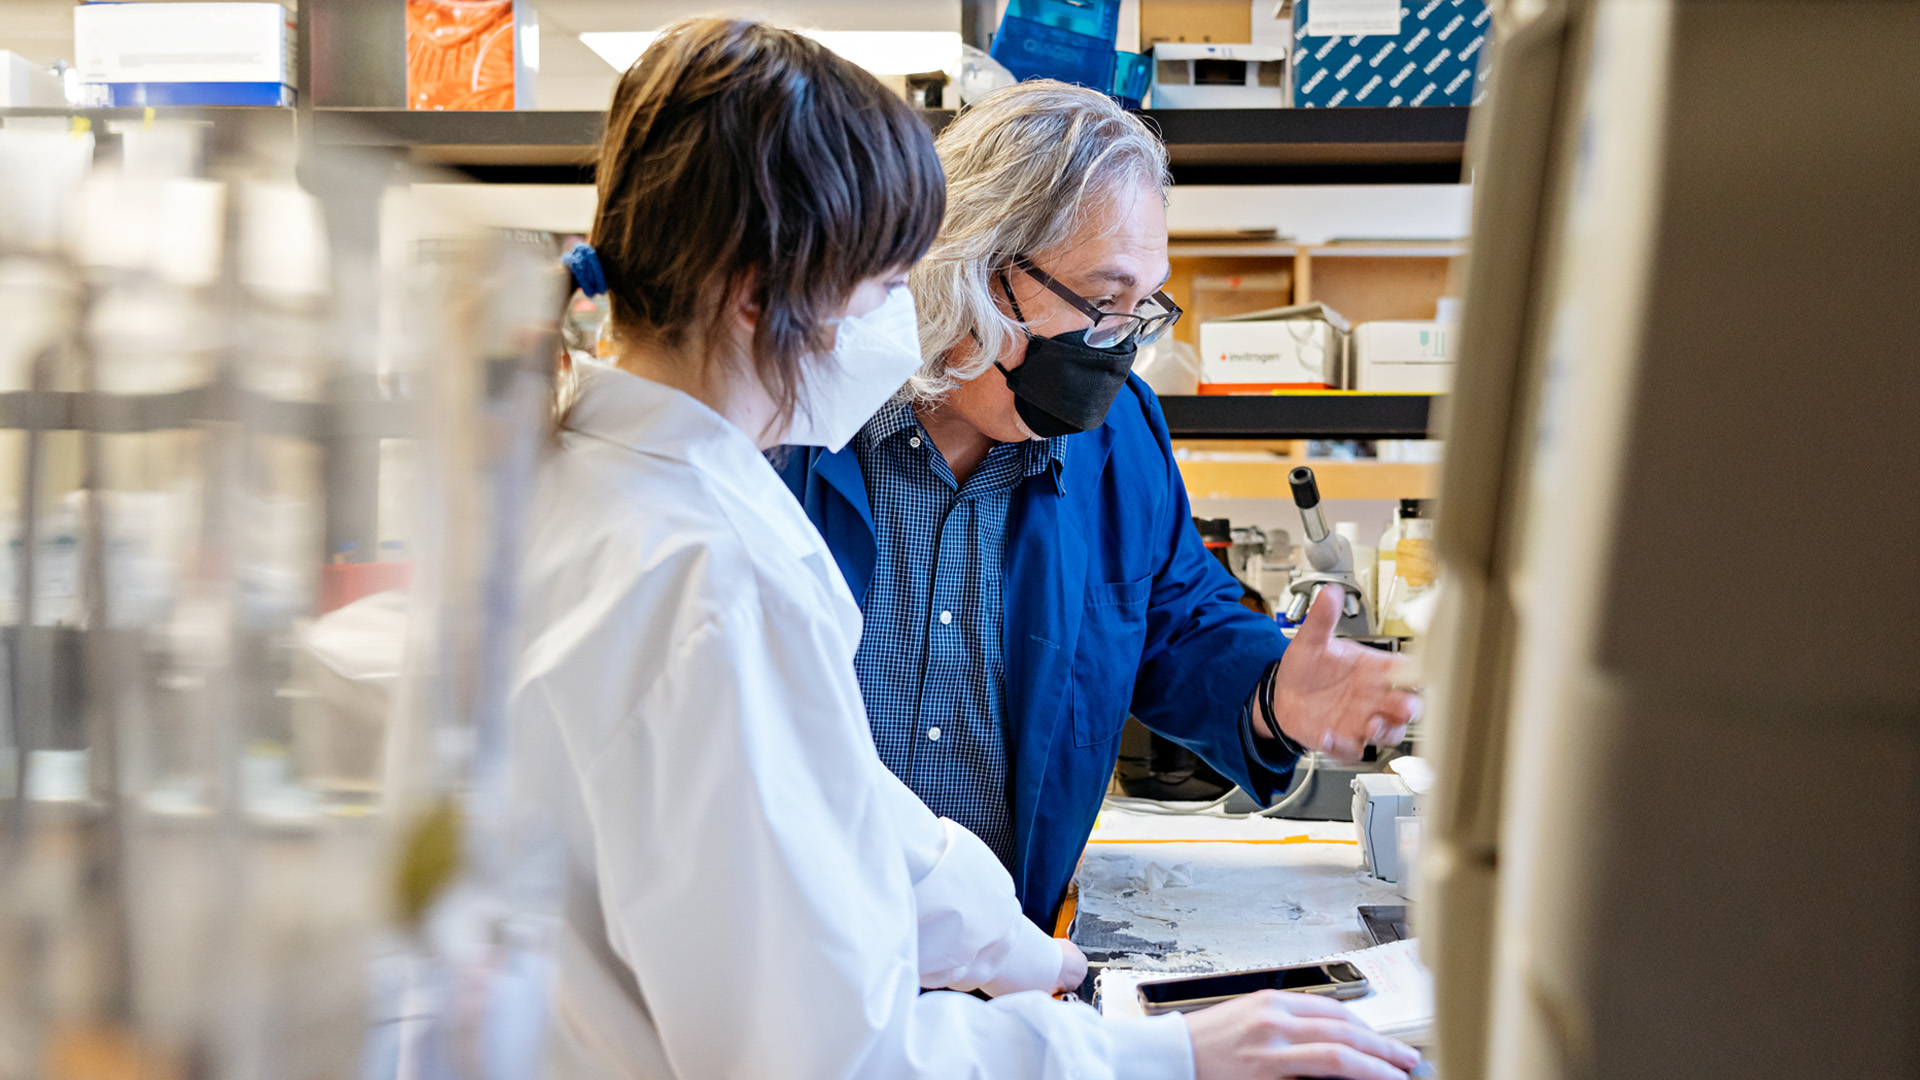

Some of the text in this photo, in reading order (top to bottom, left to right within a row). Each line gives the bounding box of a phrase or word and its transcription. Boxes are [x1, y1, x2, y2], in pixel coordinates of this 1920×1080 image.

[1403, 27, 1430, 55] QIAGEN
[1437, 14, 1465, 41] QIAGEN
[1369, 41, 1397, 67] QIAGEN
[1423, 48, 1451, 75] QIAGEN
[1458, 35, 1485, 62] QIAGEN
[1301, 67, 1329, 94] QIAGEN
[1335, 54, 1362, 81] QIAGEN
[1389, 61, 1417, 88] QIAGEN
[1355, 75, 1383, 102] QIAGEN
[1443, 69, 1472, 96] QIAGEN
[1230, 353, 1280, 364] invitrogen
